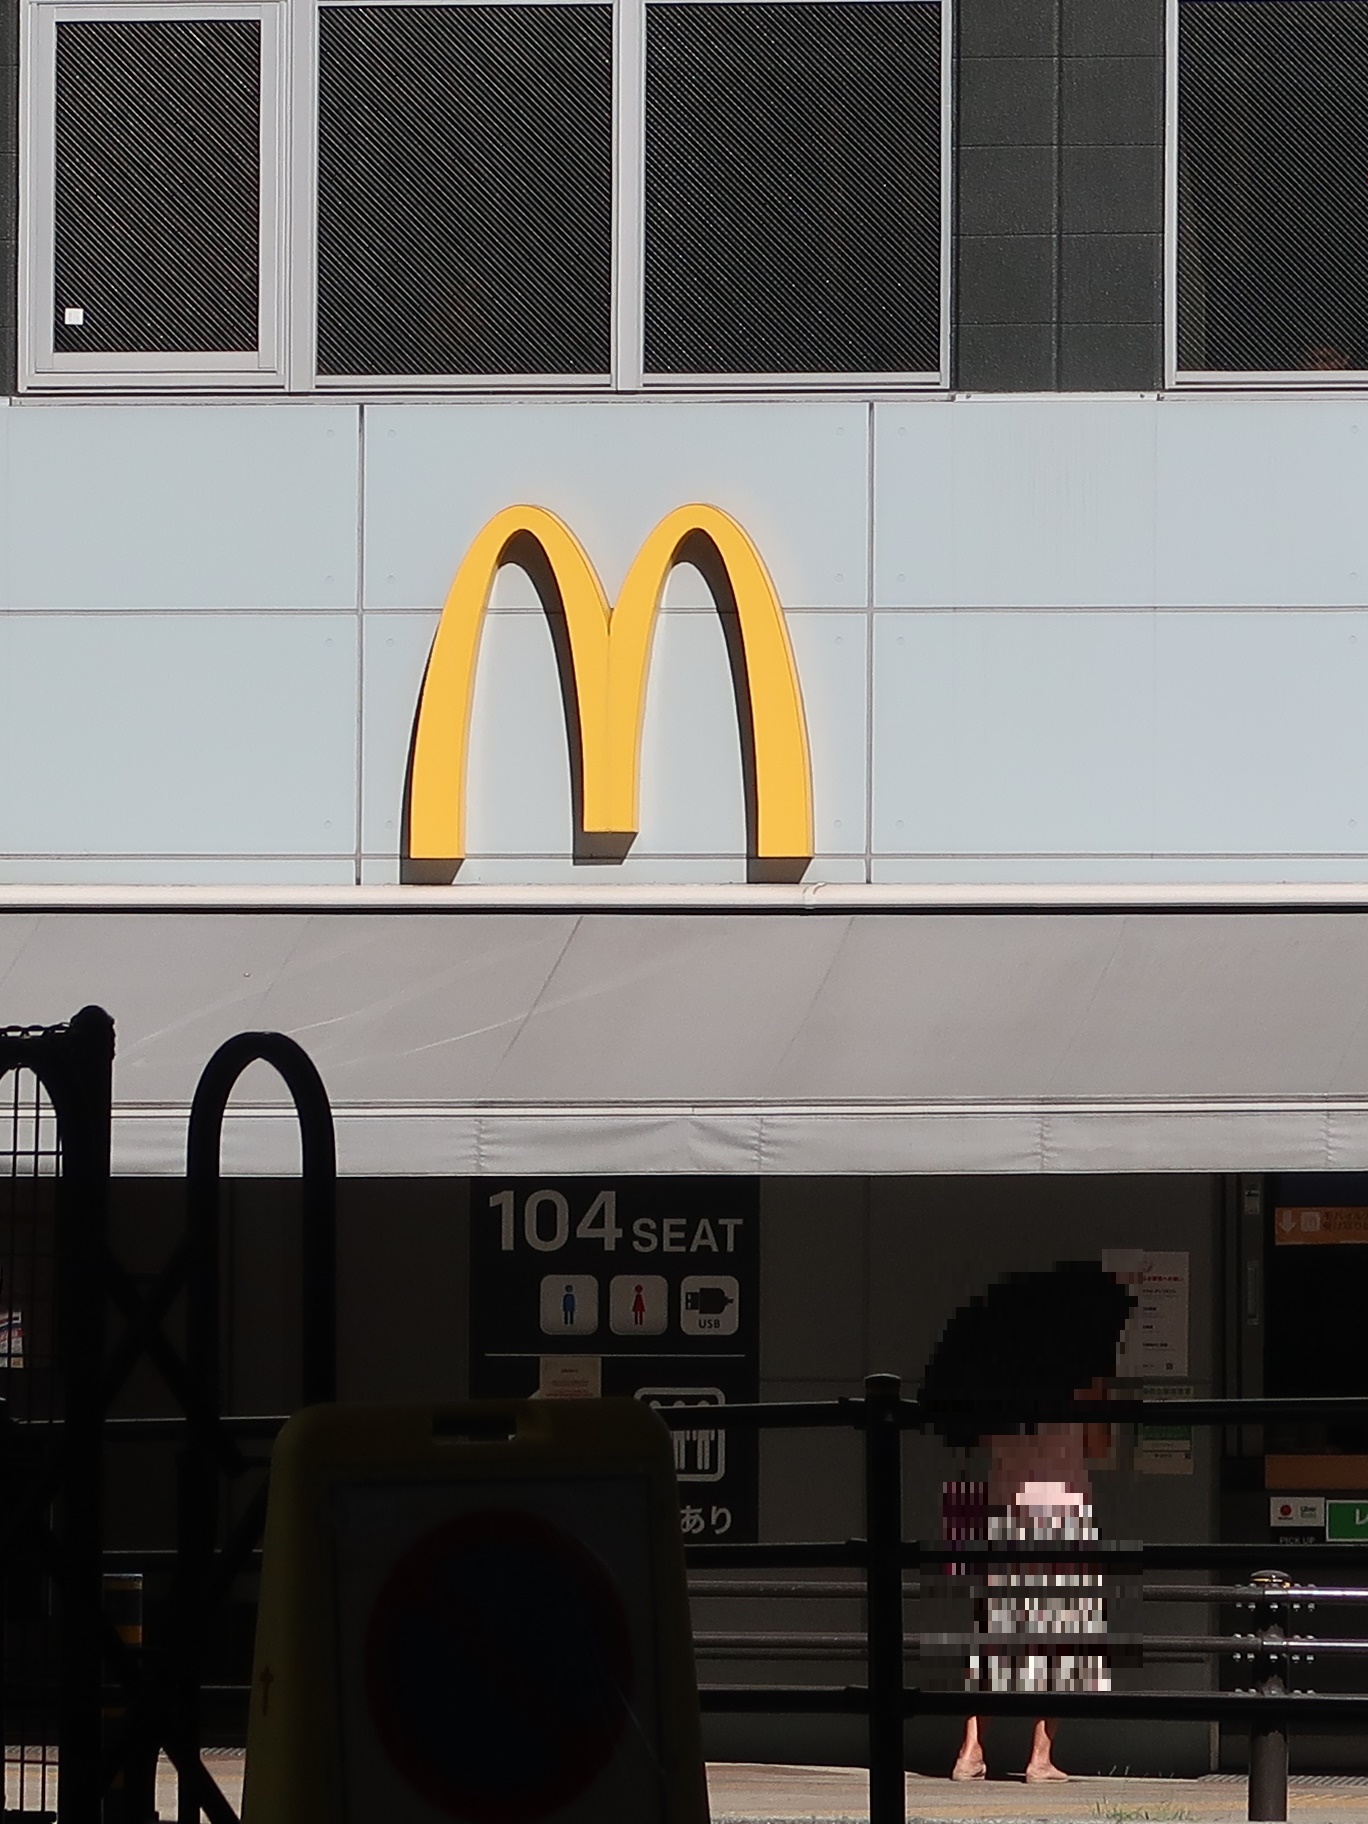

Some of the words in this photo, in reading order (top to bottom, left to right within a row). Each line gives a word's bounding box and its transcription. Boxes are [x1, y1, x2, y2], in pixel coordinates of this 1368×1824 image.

[488, 1189, 624, 1252] 104
[631, 1217, 744, 1253] SEAT
[697, 1318, 721, 1330] USB
[679, 1504, 733, 1536] あり
[1279, 1536, 1301, 1545] PICK
[1302, 1536, 1316, 1545] UP
